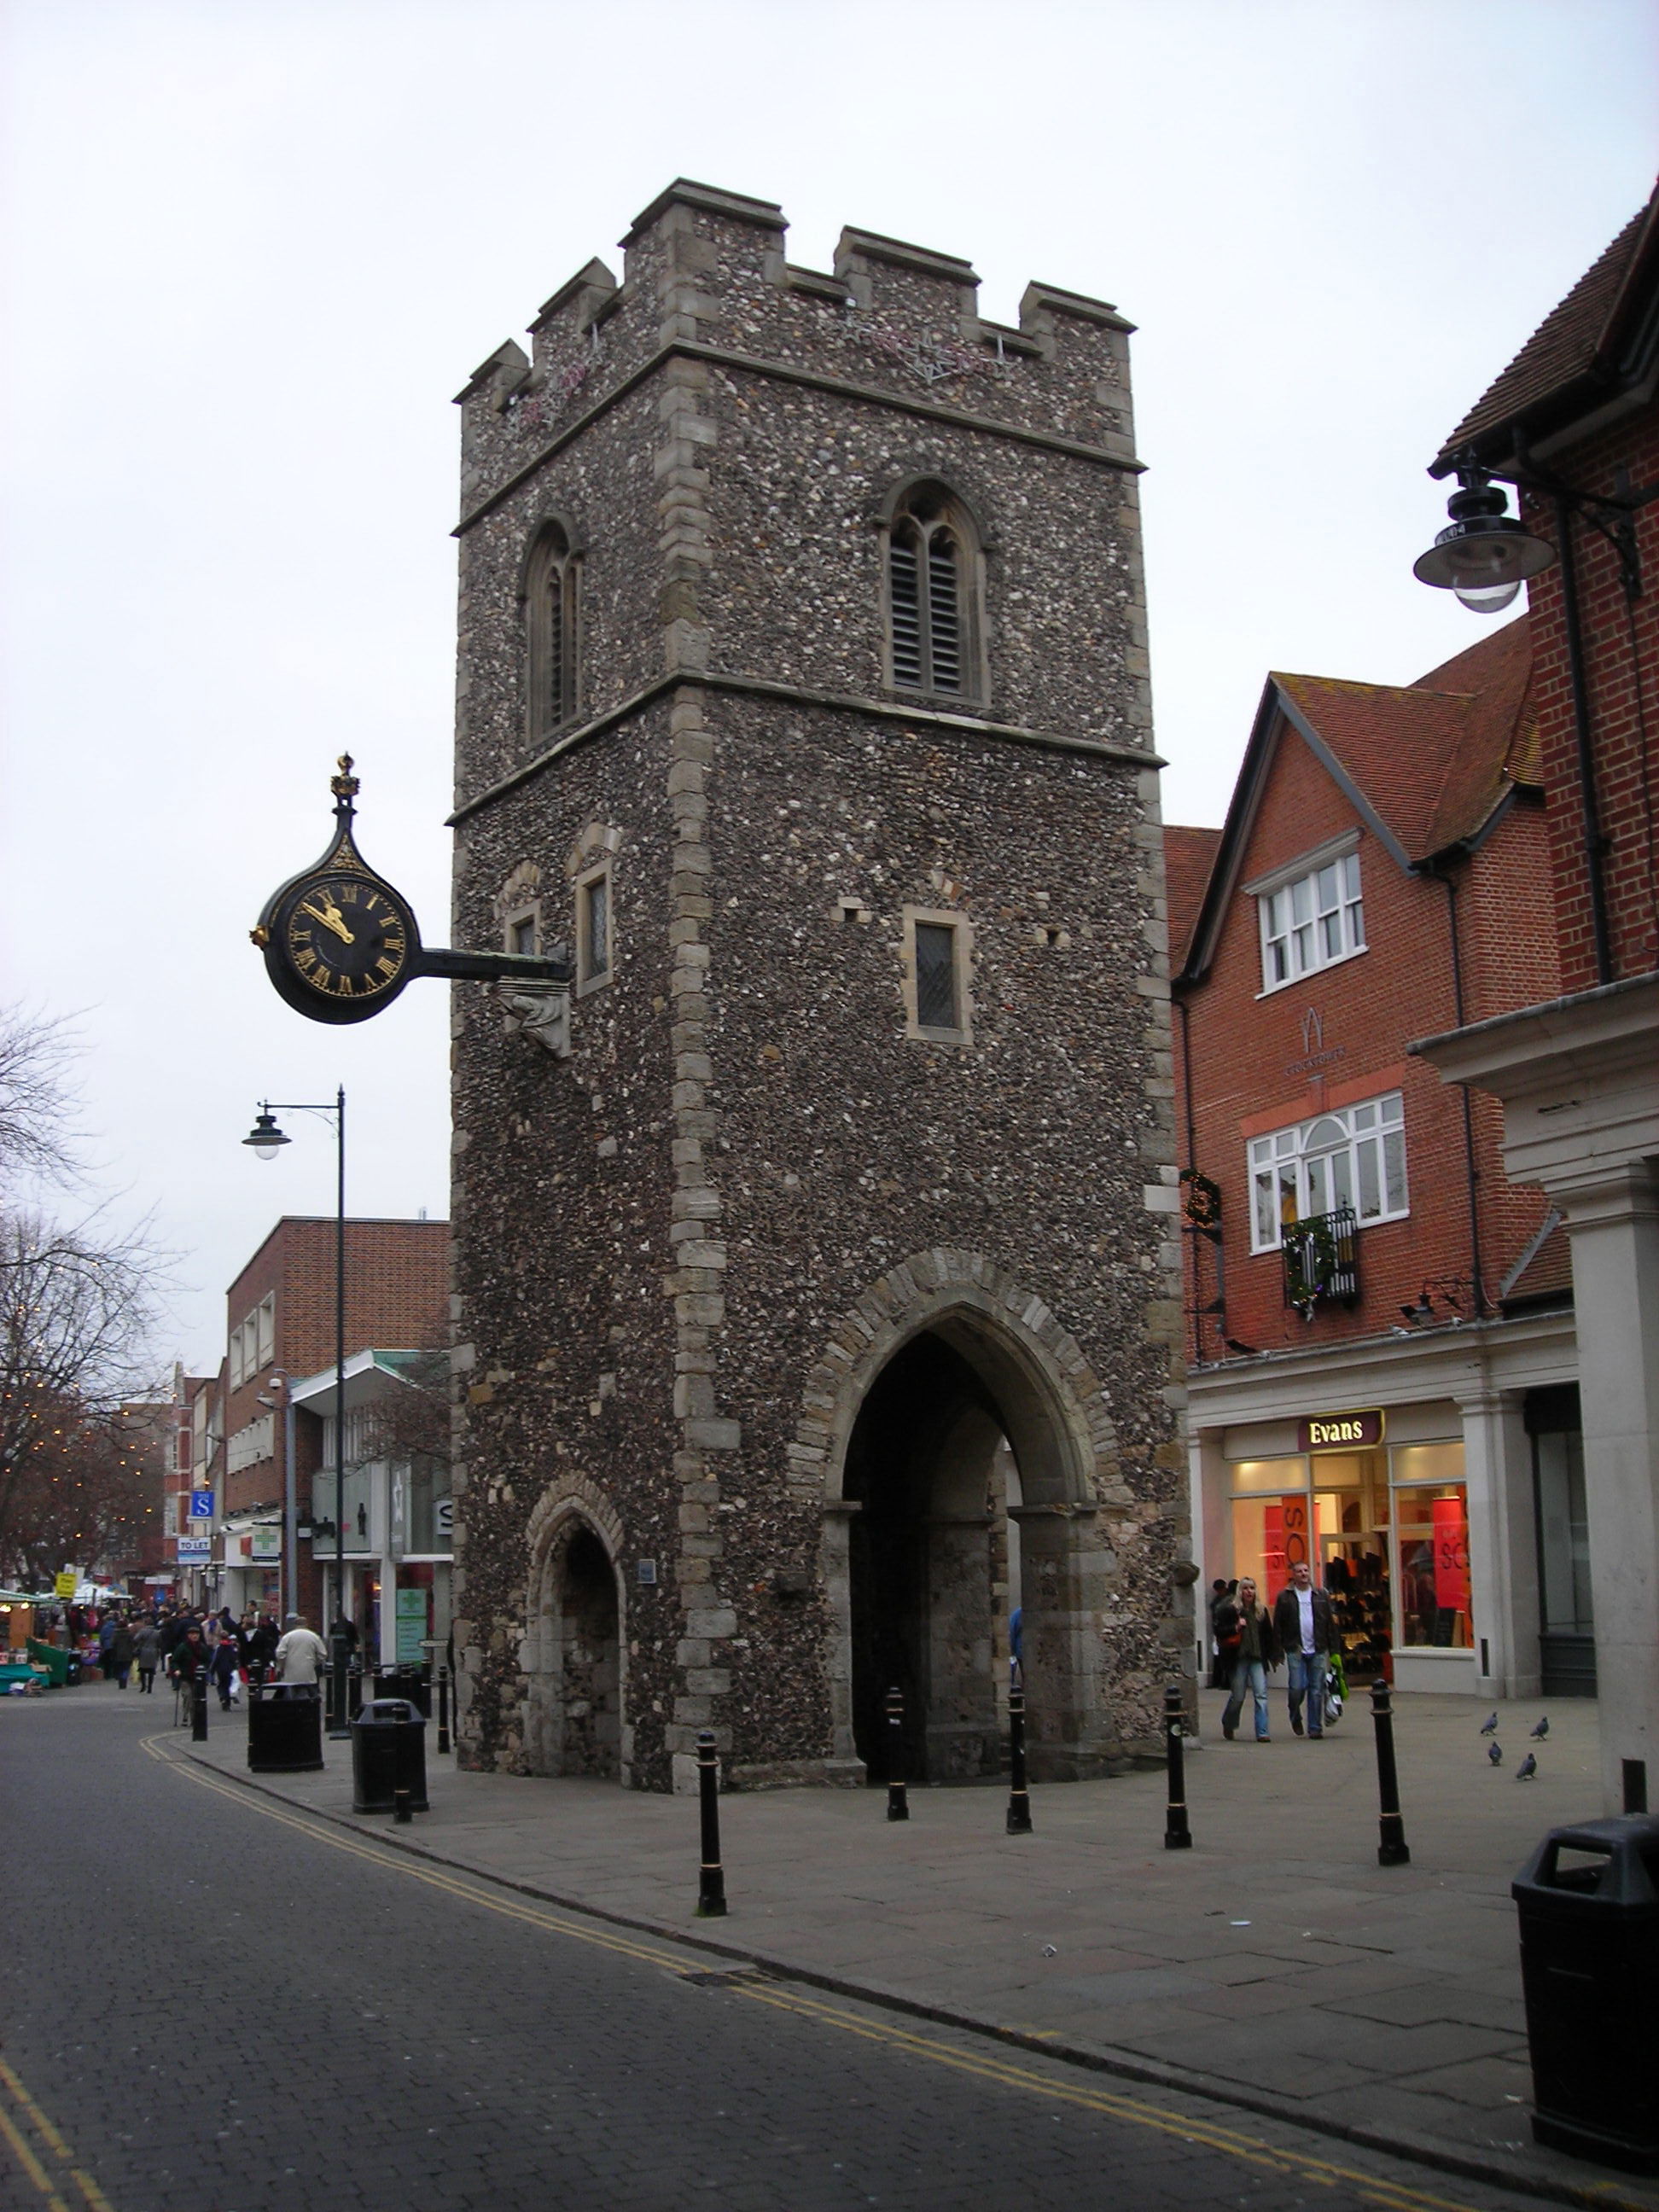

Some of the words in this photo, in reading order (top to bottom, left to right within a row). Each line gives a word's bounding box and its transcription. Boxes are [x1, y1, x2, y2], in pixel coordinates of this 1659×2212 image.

[341, 887, 357, 904] XII
[365, 894, 379, 911] I
[379, 917, 397, 928] II
[383, 938, 402, 952] III
[1309, 1420, 1364, 1444] Evans
